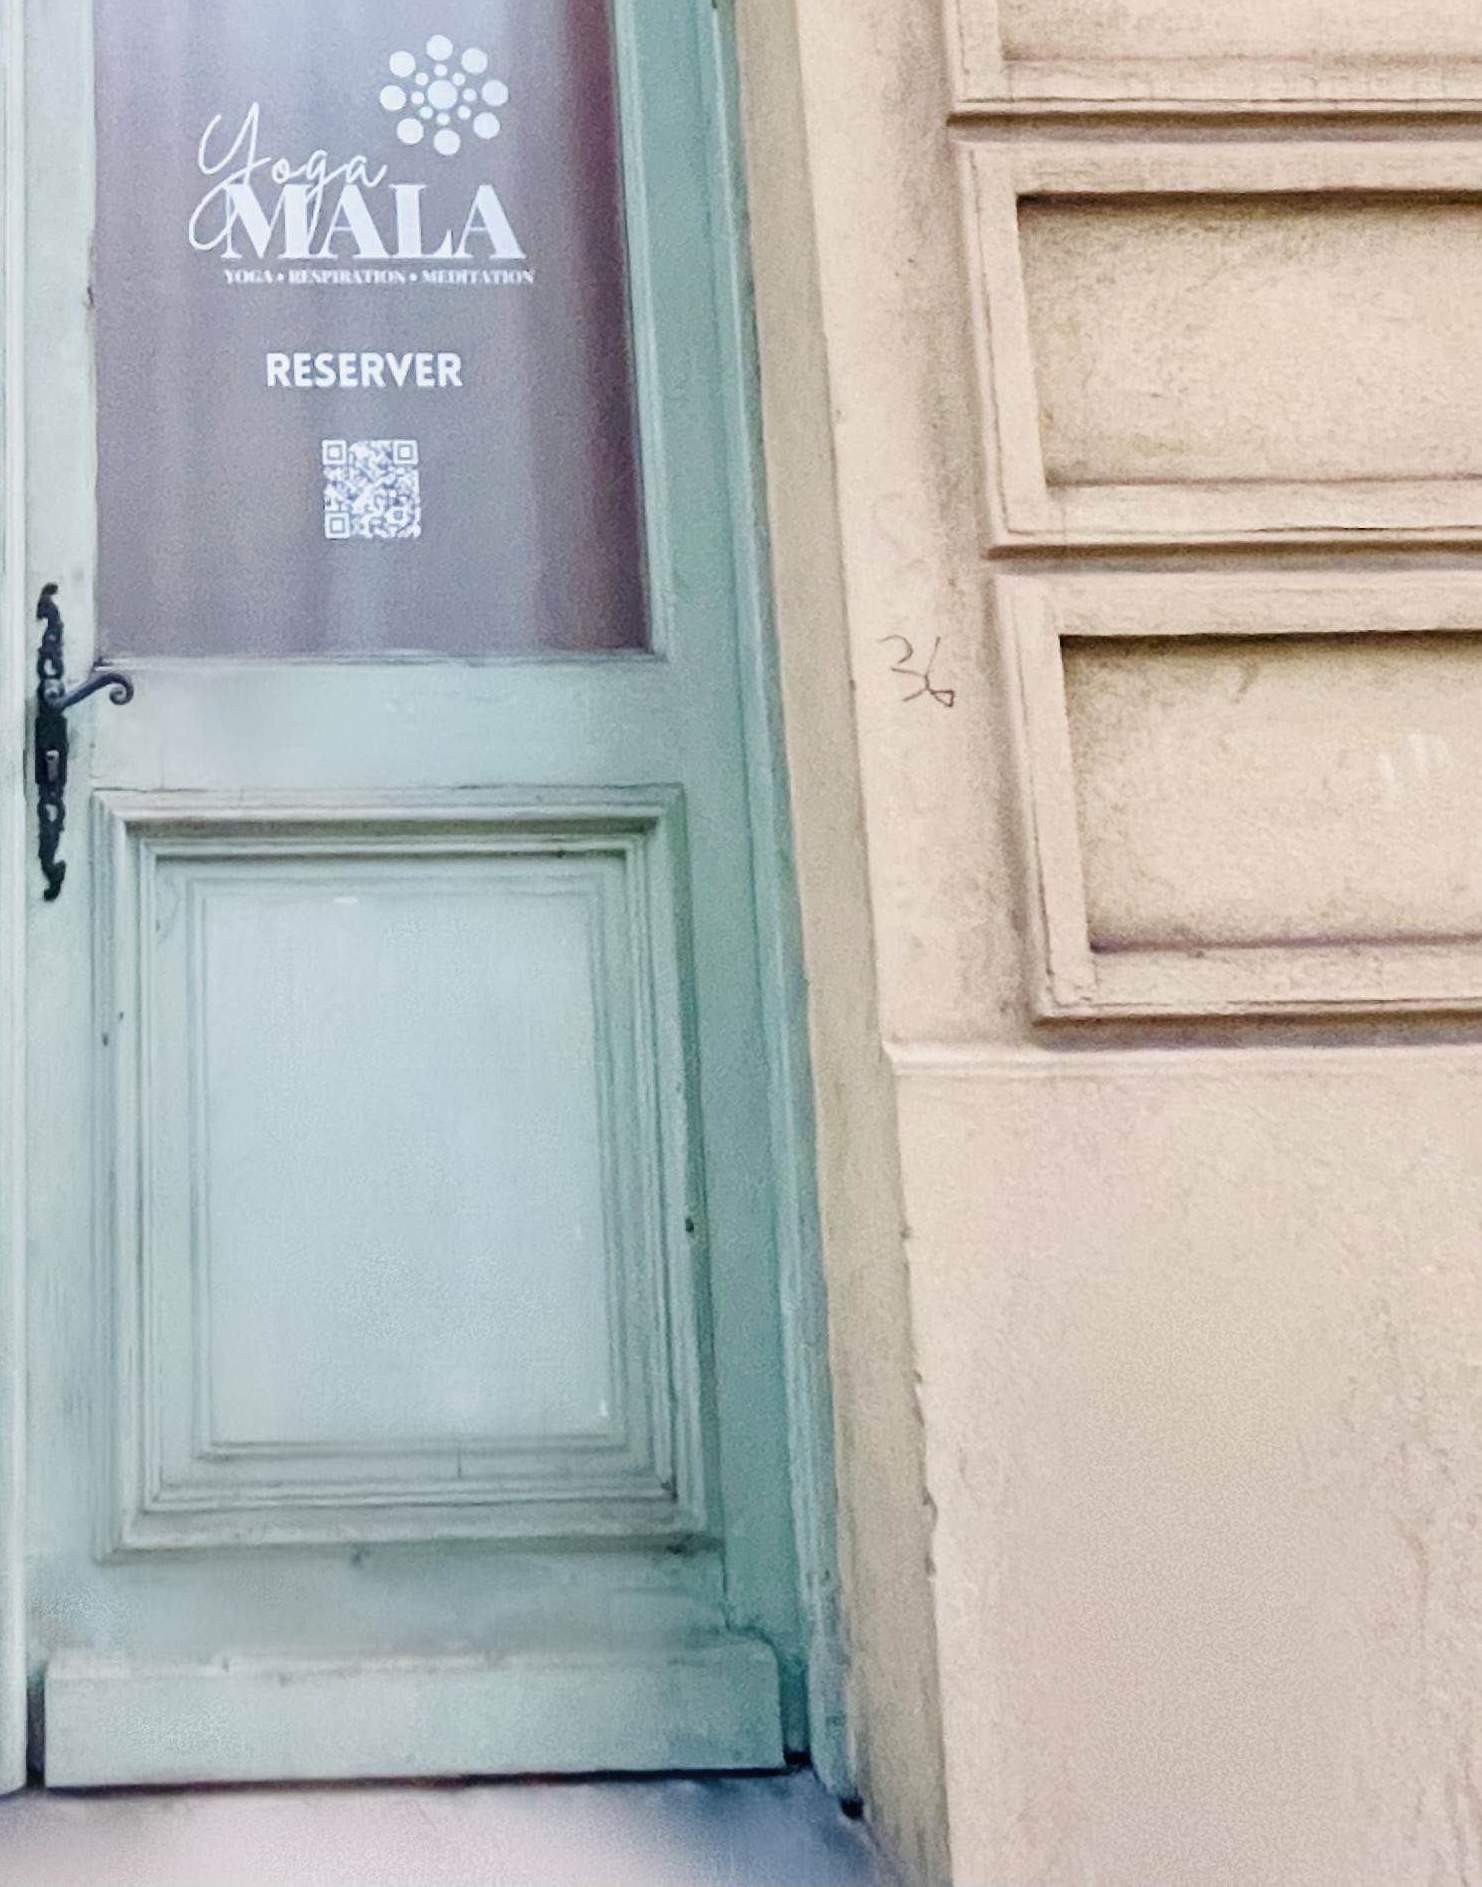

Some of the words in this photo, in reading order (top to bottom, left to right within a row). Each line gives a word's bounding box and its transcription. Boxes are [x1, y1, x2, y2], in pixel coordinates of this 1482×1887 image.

[189, 101, 387, 254] Yoga
[220, 183, 526, 259] MALA
[224, 269, 274, 285] YOGA
[288, 268, 406, 285] RESPIRATION
[421, 268, 535, 285] MEDITATION
[266, 352, 463, 387] RESERVER
